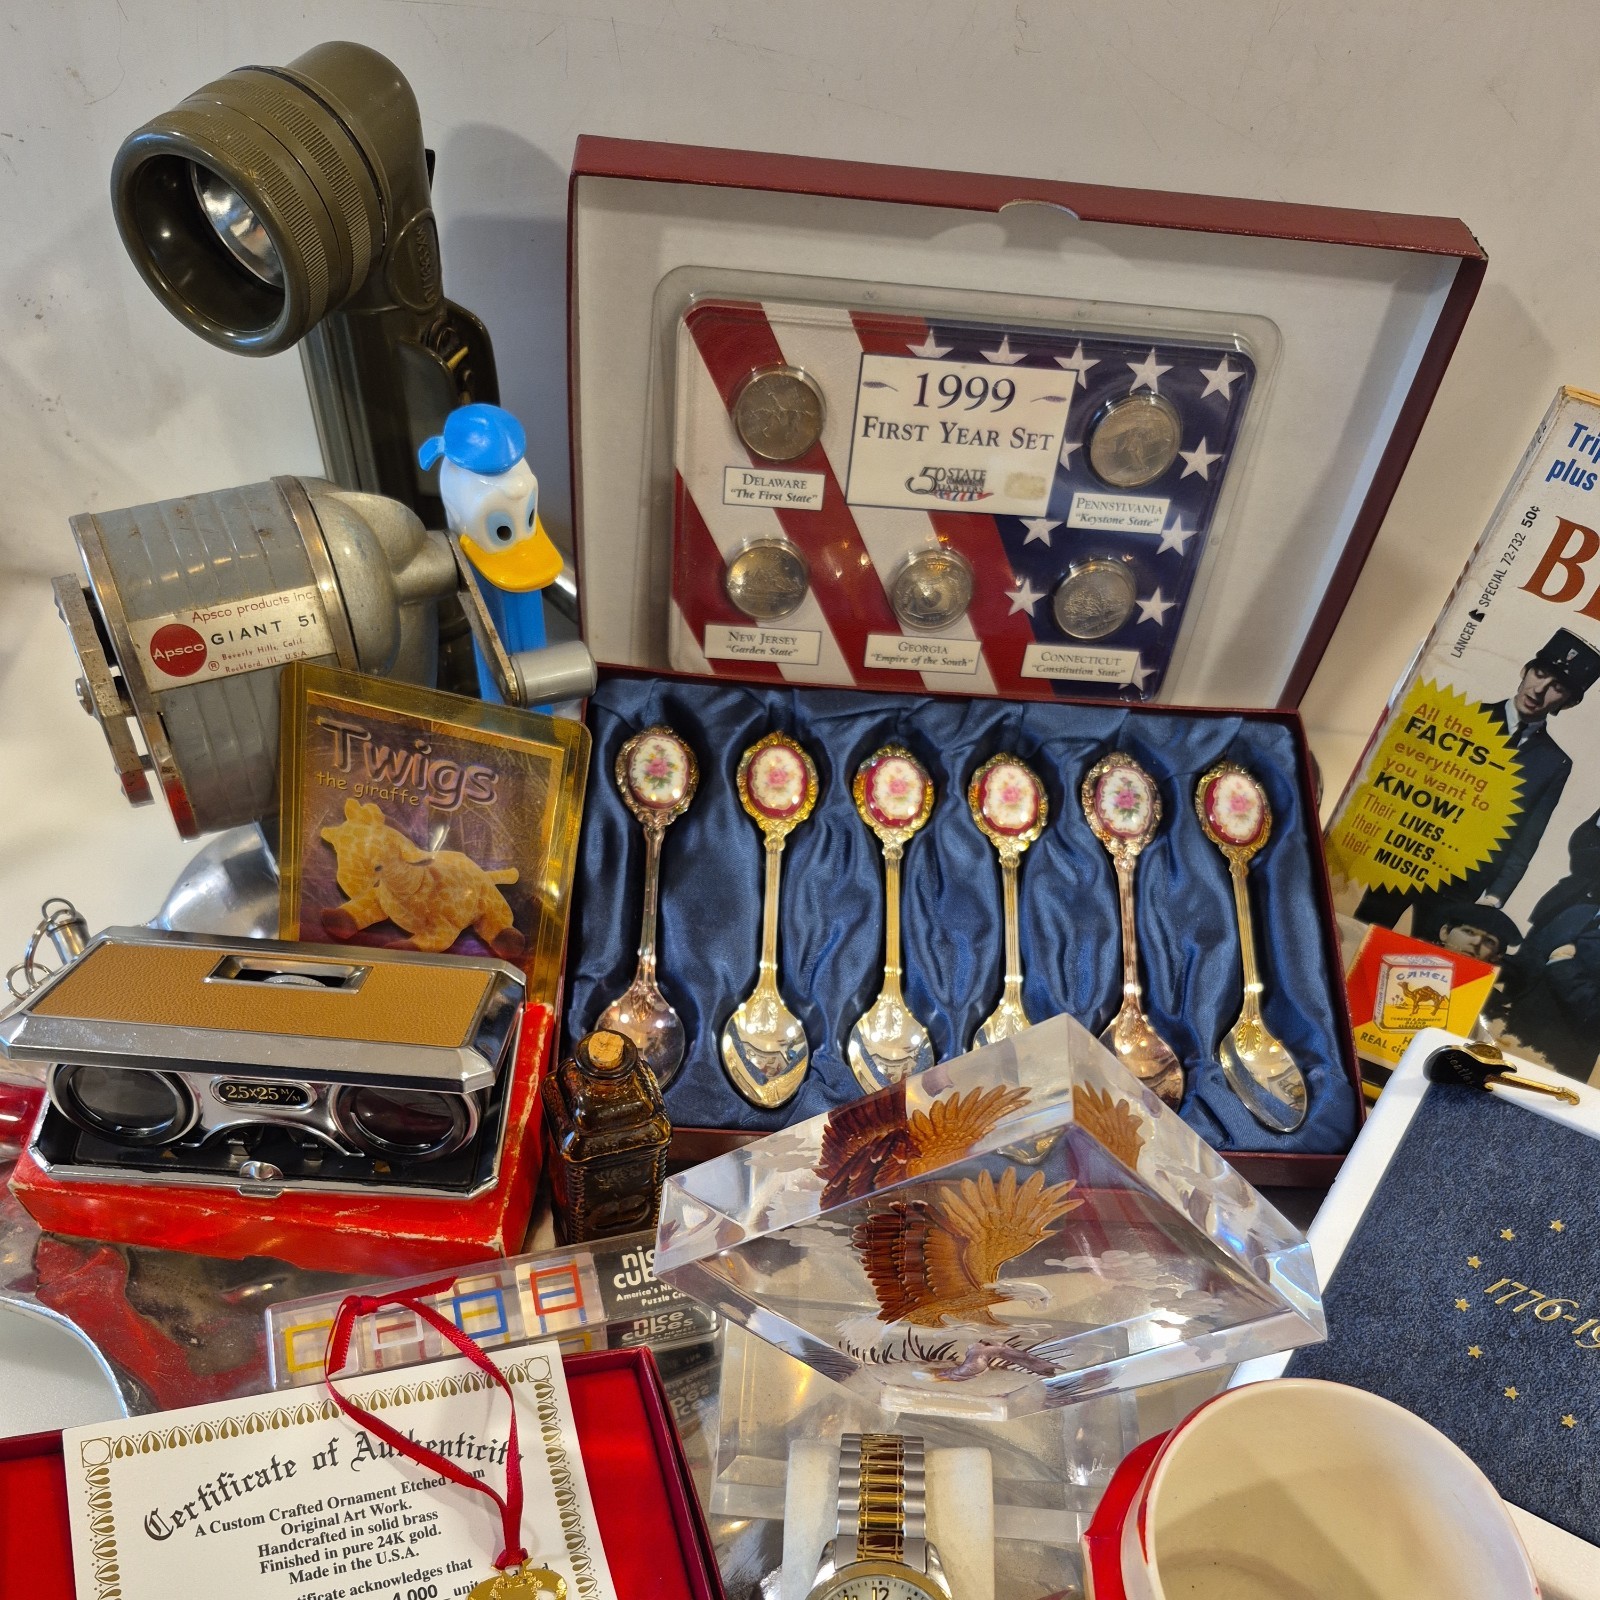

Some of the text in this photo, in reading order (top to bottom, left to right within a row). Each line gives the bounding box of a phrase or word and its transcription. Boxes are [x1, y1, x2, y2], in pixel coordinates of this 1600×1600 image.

[913, 373, 1016, 413] 1999
[743, 474, 807, 489] DELAWARE
[947, 468, 987, 480] STATE
[1545, 458, 1598, 491] plus
[759, 491, 782, 501] First
[1517, 515, 1600, 621] B
[192, 609, 232, 625] Apsco
[237, 595, 290, 617] products
[1450, 621, 1478, 659] LANCER
[1478, 568, 1507, 608] SPECIAL
[1501, 532, 1526, 565] 72-732
[211, 613, 317, 645] GIANT 51
[153, 643, 204, 661] Apsco
[222, 649, 253, 661] Beverly
[911, 656, 922, 666] of
[923, 656, 938, 664] the
[1415, 703, 1473, 738] All the
[316, 716, 499, 812] Twigs
[1394, 741, 1489, 792] everything
[316, 771, 420, 807] the giraffe
[1373, 771, 1466, 824] KNOW!
[1383, 757, 1490, 812] you want to
[1361, 793, 1397, 821] Their
[1351, 813, 1382, 839] their
[1341, 831, 1430, 883] their MUSIC
[1396, 970, 1448, 983] CAMEL
[1360, 1032, 1387, 1049] REAL
[622, 1245, 655, 1269] nic
[614, 1265, 657, 1288] cub
[616, 1286, 658, 1301] America's
[642, 1294, 670, 1306] Puzzle
[144, 1428, 524, 1541] Certificate of Auenticit
[194, 1524, 206, 1537] A
[210, 1514, 265, 1534] Custom
[269, 1498, 324, 1521] Crafted
[327, 1486, 396, 1510] Ornament
[401, 1475, 446, 1495] Etched
[281, 1499, 412, 1536] Original Art Work.
[257, 1511, 439, 1558] Handcrafted in solid brass
[259, 1524, 442, 1574] Finished in pure 24K gold.
[288, 1547, 420, 1585] Made in the U.S.A.
[349, 1567, 443, 1597] acknowledges
[446, 1558, 474, 1574] that
[453, 1580, 480, 1597] unit
